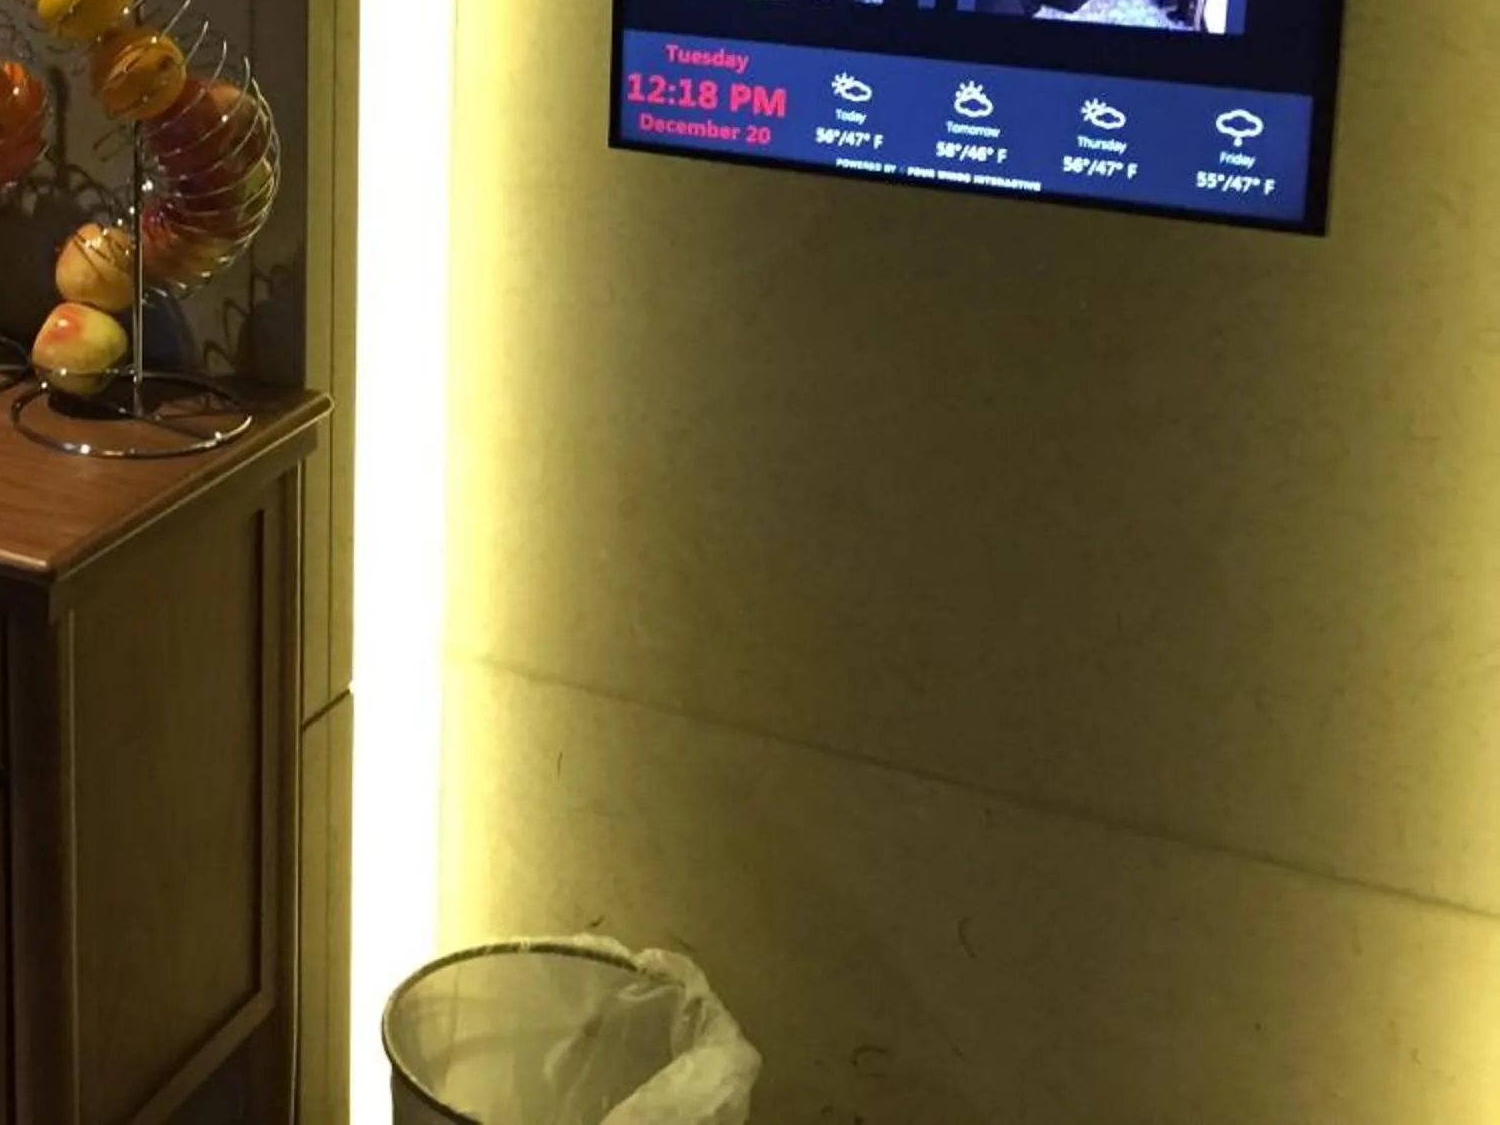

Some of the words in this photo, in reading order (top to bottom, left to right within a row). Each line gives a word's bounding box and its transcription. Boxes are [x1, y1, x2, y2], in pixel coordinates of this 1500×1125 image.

[665, 43, 750, 74] Tuesday
[627, 73, 719, 110] 12:18
[729, 83, 788, 118] PM
[835, 107, 867, 126] Today
[639, 112, 741, 141] December
[746, 125, 772, 145] 20
[945, 120, 1000, 139] Tomorrow
[1077, 135, 1128, 156] Thursday
[1220, 151, 1257, 170] Friday
[1127, 162, 1139, 180] F
[1264, 178, 1276, 196] F
